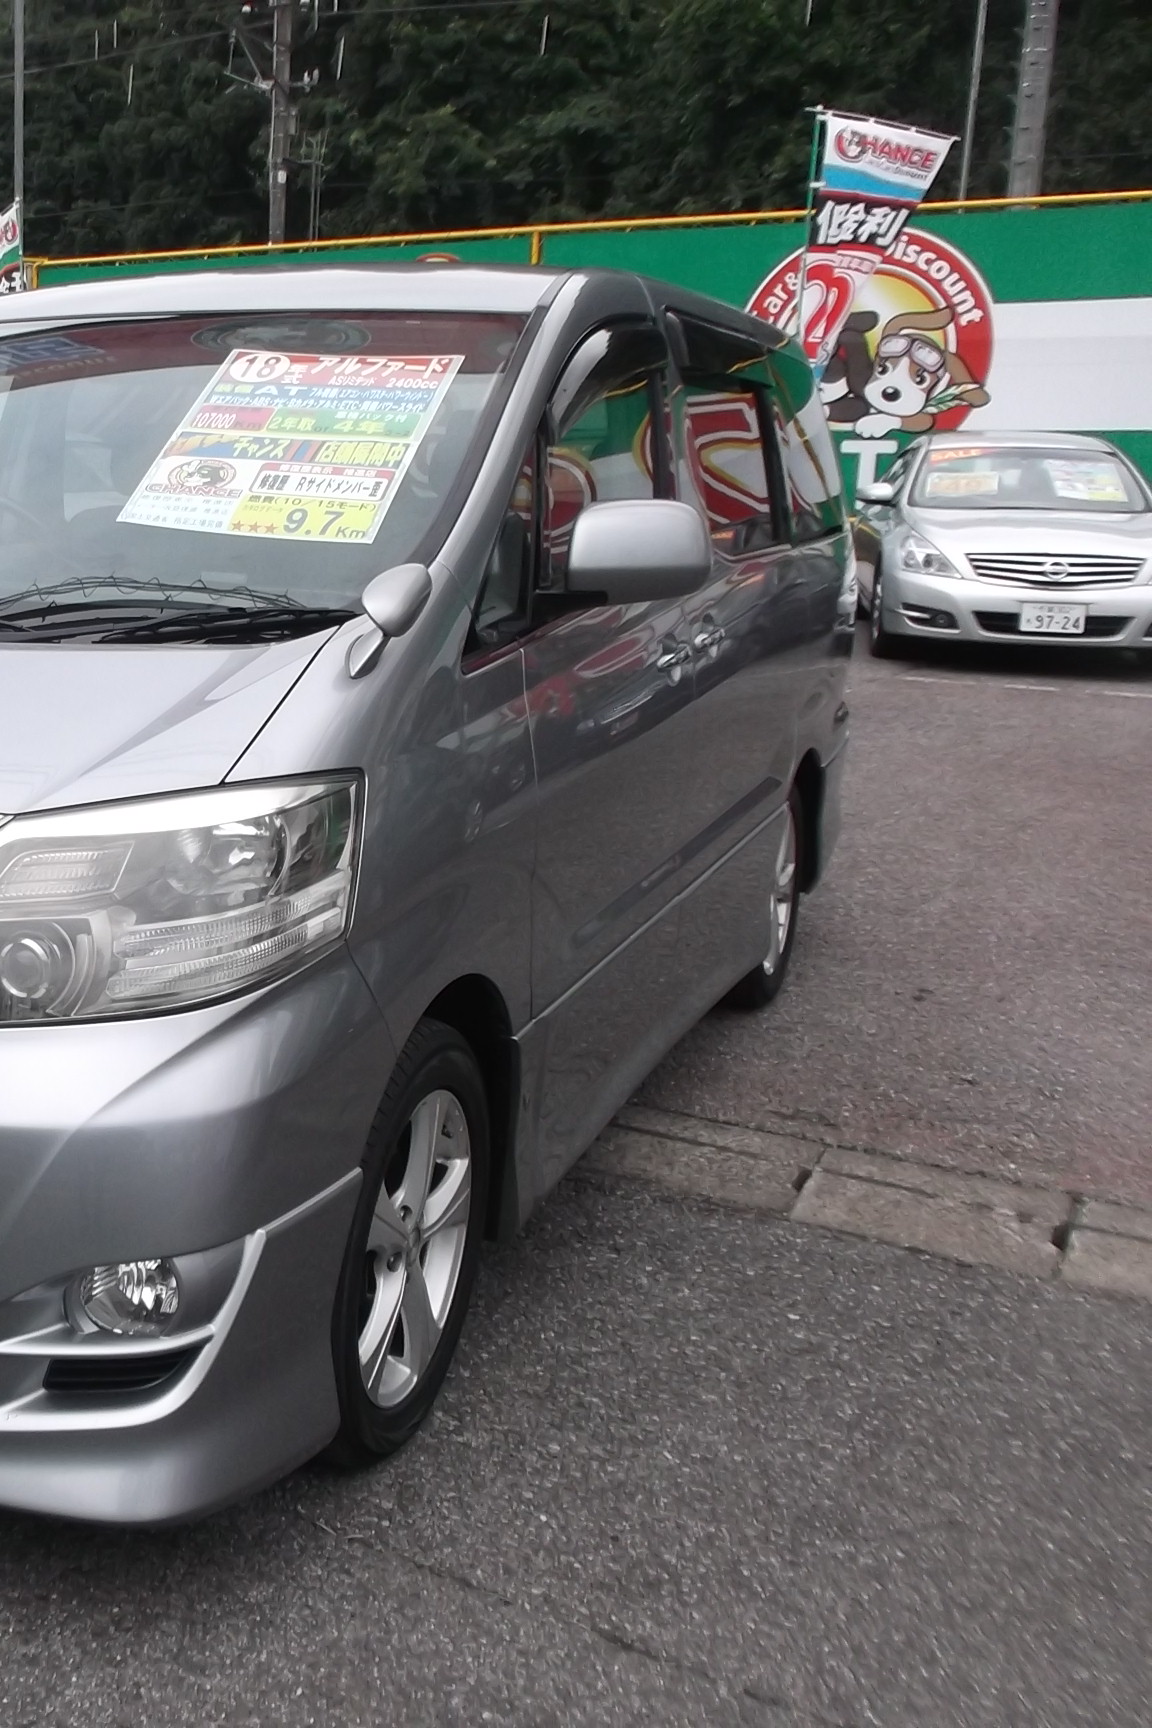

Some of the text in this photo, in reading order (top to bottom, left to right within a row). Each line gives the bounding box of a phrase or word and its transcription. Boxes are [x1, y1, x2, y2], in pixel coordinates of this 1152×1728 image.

[833, 126, 942, 174] CHANCE
[310, 356, 450, 380] アルファード
[386, 377, 439, 389] 2400cc
[191, 412, 237, 430] 107000
[232, 436, 291, 459] チャンス
[145, 483, 244, 498] CHANCE
[283, 508, 345, 536] 9.7
[1035, 614, 1081, 630] 97-24
